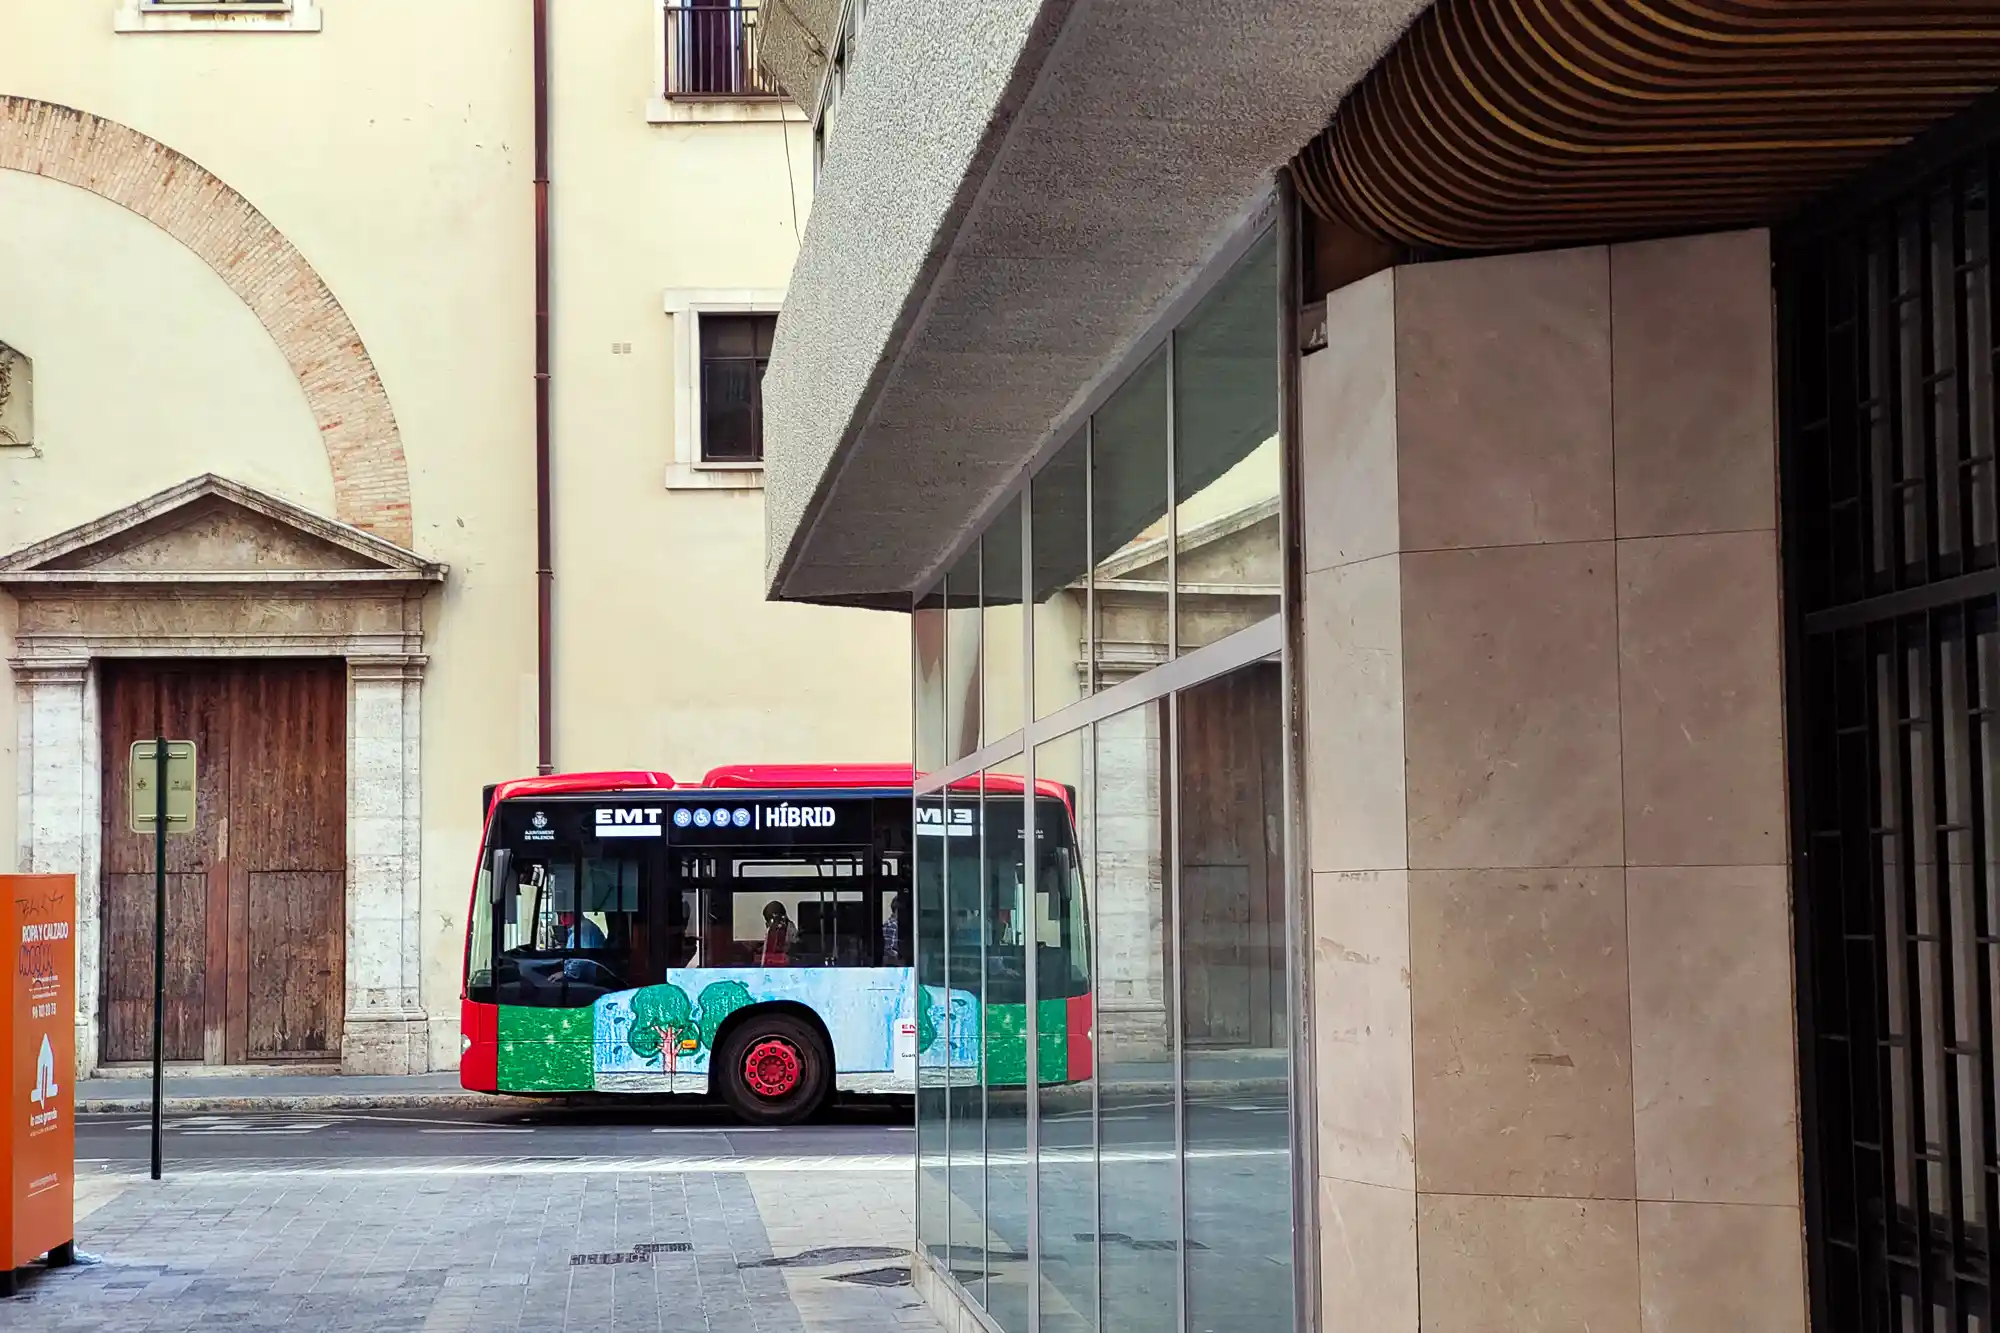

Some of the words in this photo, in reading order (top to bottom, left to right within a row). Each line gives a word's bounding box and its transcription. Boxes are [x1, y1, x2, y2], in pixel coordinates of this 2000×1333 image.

[595, 808, 663, 824] EMT
[766, 801, 836, 827] HÍBRID
[22, 925, 38, 943] ROPA
[43, 921, 69, 940] CALZADO
